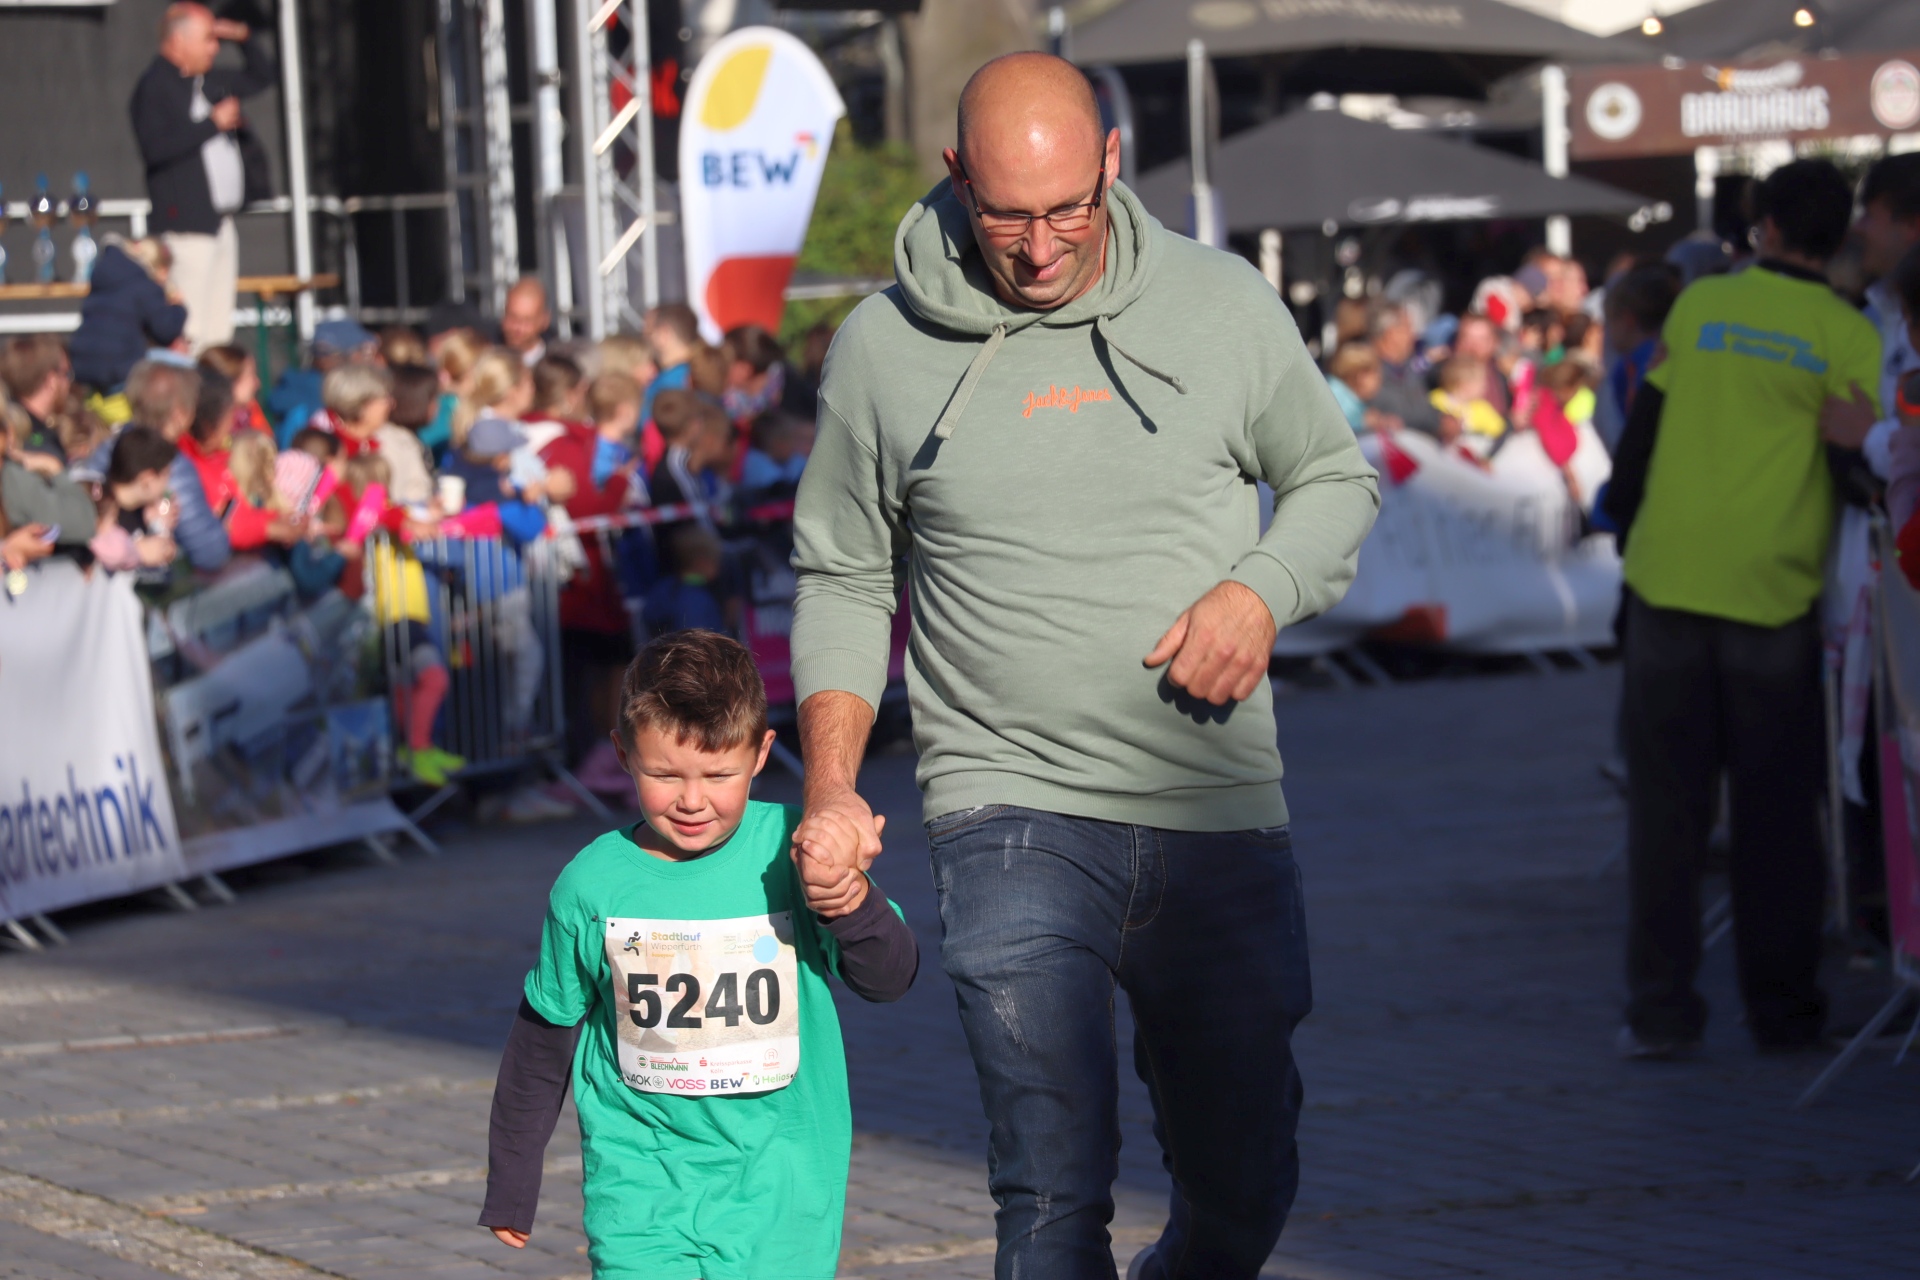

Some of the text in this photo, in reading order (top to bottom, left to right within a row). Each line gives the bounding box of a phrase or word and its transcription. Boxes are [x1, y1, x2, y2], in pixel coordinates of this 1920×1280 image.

[700, 152, 799, 187] BEW
[0, 752, 168, 886] artechnik
[651, 931, 701, 941] Stadtlauf
[627, 968, 781, 1029] 5240
[630, 1073, 652, 1087] AOK
[666, 1078, 707, 1090] VOSS
[710, 1077, 744, 1090] BEW
[762, 1073, 790, 1084] Helios
